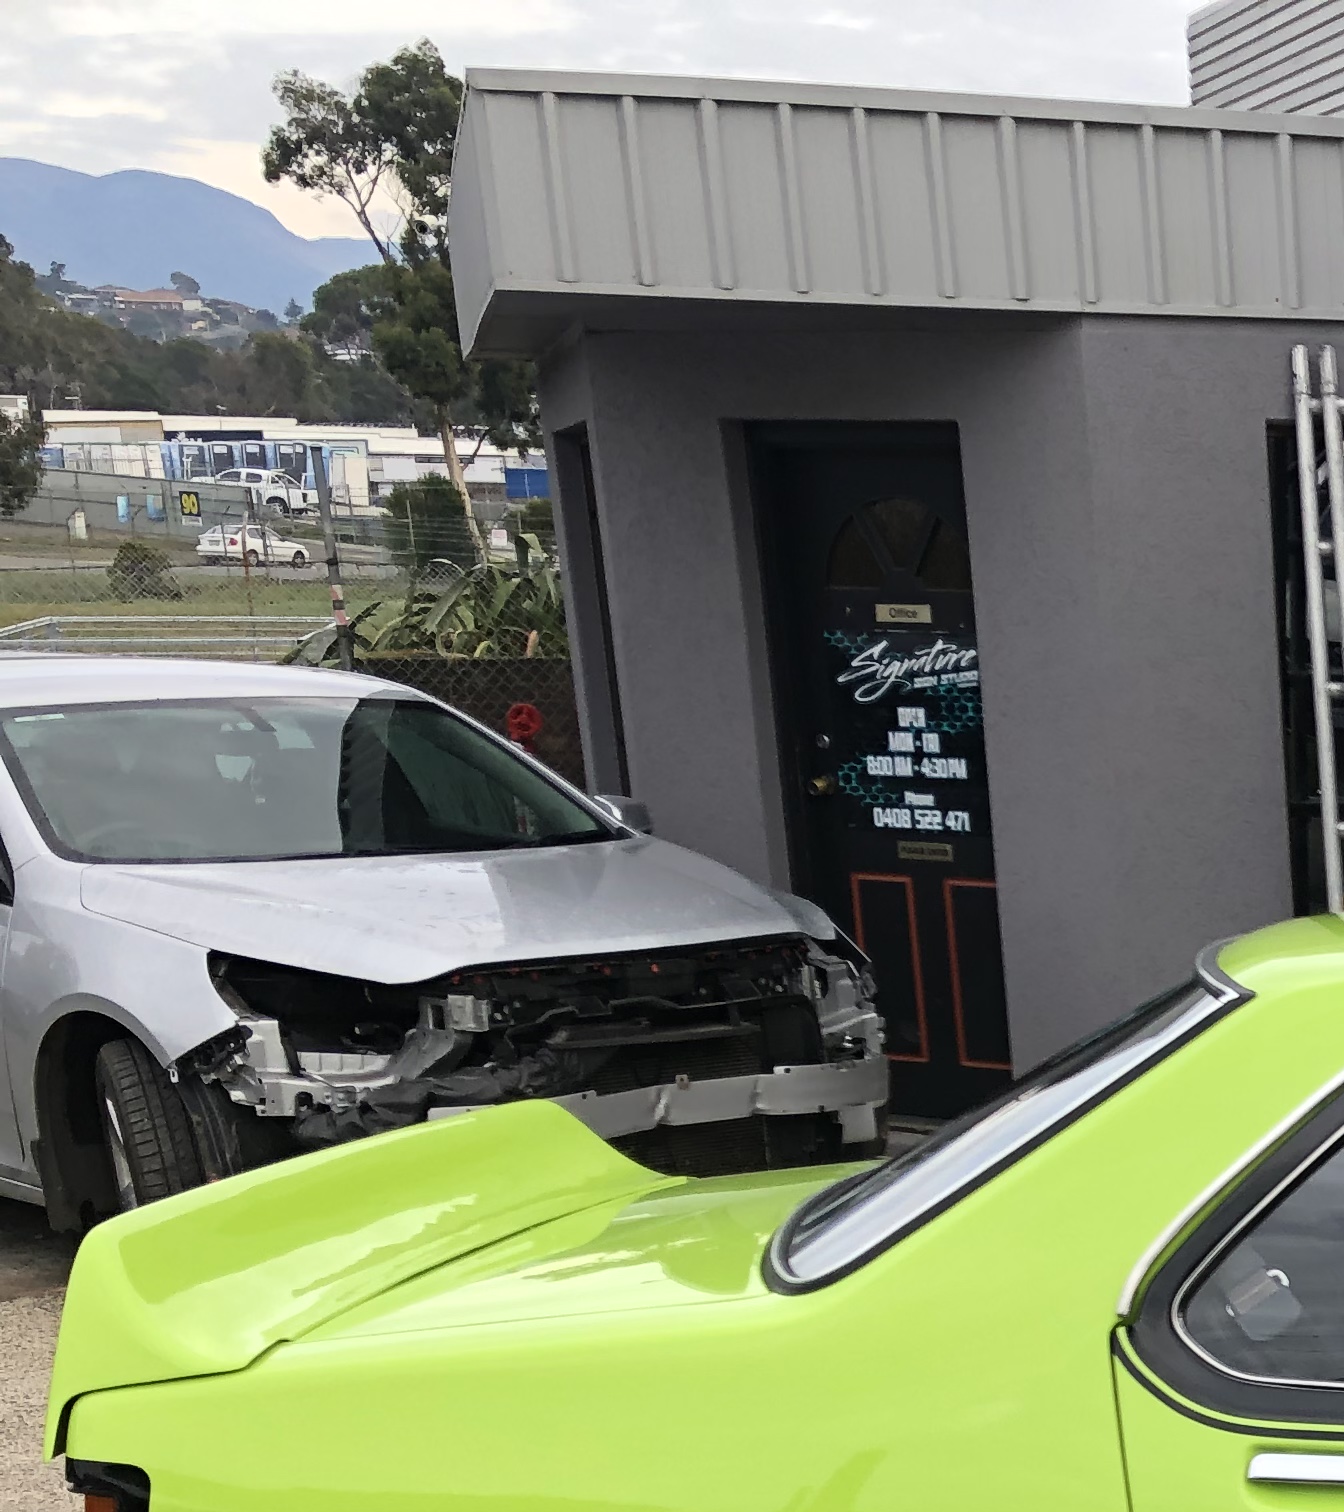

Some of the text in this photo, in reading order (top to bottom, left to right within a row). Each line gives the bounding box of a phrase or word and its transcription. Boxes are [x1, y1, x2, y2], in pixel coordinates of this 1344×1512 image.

[182, 493, 198, 514] 90
[837, 638, 977, 702] Signature
[873, 807, 972, 833] 0408 522 471
